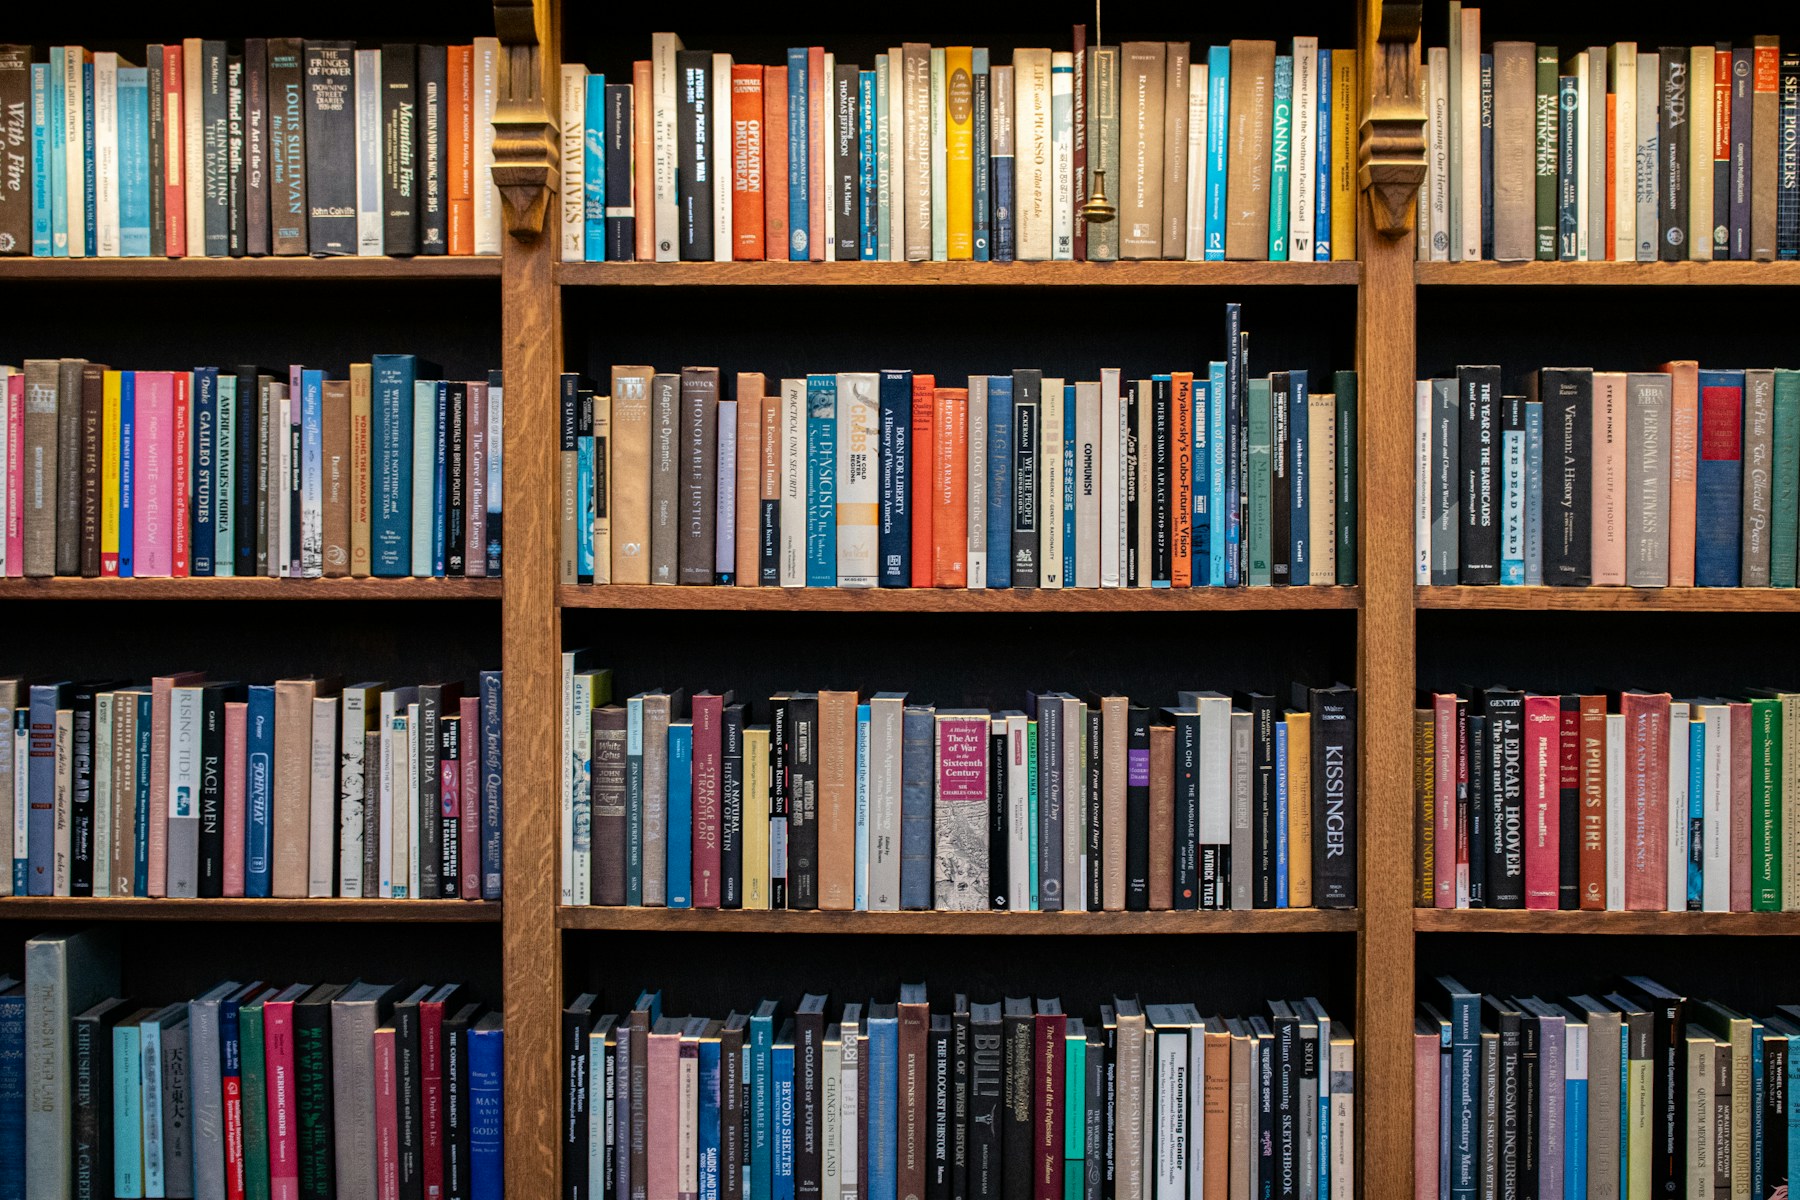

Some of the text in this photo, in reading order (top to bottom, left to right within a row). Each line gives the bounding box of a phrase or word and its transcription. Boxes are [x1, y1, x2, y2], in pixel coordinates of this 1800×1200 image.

[67, 50, 78, 142] Colonial Latin America
[1301, 56, 1309, 91] Seashore
[1482, 68, 1491, 128] THE LEGACY
[7, 101, 25, 191] With Fire
[230, 63, 241, 173] The Mind of Stalin
[287, 84, 301, 214] LOUIS SULLIVAN
[400, 101, 413, 197] Mountain Fires
[695, 68, 705, 182] ATOMS for PEACE and WAR
[1274, 104, 1288, 172] CANNAE
[1301, 110, 1308, 118] of
[1537, 94, 1547, 176] EXTINCTION
[1547, 95, 1558, 175] WILDLIFE
[1785, 76, 1797, 189] SETI PIONEERS
[206, 124, 216, 198] THE BAZAAR
[216, 119, 227, 206] REINVENTING
[736, 121, 748, 192] DRUMBEAT
[748, 120, 760, 193] OPERATION
[878, 115, 888, 207] VICO & JOYCE
[453, 393, 461, 443] FUNDAMENTALS
[661, 384, 672, 472] Adaptive Dynamics
[1481, 383, 1490, 526] THE YEAR OF THE BARRICADES
[177, 455, 183, 466] on
[199, 411, 210, 522] GALILEO STUDIES
[452, 479, 461, 506] POLITICS
[453, 453, 461, 477] BRITISH
[691, 399, 703, 538] HONORABLE JUSTICE
[896, 427, 904, 515] BORN FOR LIBERTY
[1025, 457, 1032, 471] WE
[1084, 443, 1092, 496] COMMUNISM
[1179, 382, 1189, 558] Mayakovsky's Cubo-Futurist Vision
[1561, 405, 1576, 508] Vietnam: A History
[177, 497, 184, 507] of
[425, 698, 435, 783] A BETTER IDEA
[859, 722, 867, 753] Bushido
[859, 754, 867, 767] and
[859, 769, 867, 781] the
[946, 769, 980, 778] Century
[204, 756, 218, 834] RACE MEN
[858, 804, 867, 826] Living
[859, 783, 867, 794] Art
[1326, 745, 1344, 859] KISSINGER
[1505, 720, 1520, 877] J. EDGAR HOOVER
[1586, 738, 1601, 851] APOLLO'S FIRE
[1204, 850, 1214, 906] PATRICK TYLER
[78, 1023, 90, 1108] KHRUSHCHEV
[973, 1034, 1000, 1097] BULL!
[1305, 1042, 1313, 1074] SEOUL
[276, 1065, 286, 1136] APERIODIC ORDER
[472, 1127, 498, 1135] GODS
[827, 1077, 835, 1122] CHANGES
[937, 1039, 947, 1160] THE HOLOCAUST IN HISTORY
[1176, 1067, 1184, 1133] Encompassing
[1281, 1024, 1291, 1195] William Cumming SKETCHBOOK
[1460, 1049, 1472, 1185] Nineteenth-Century Music
